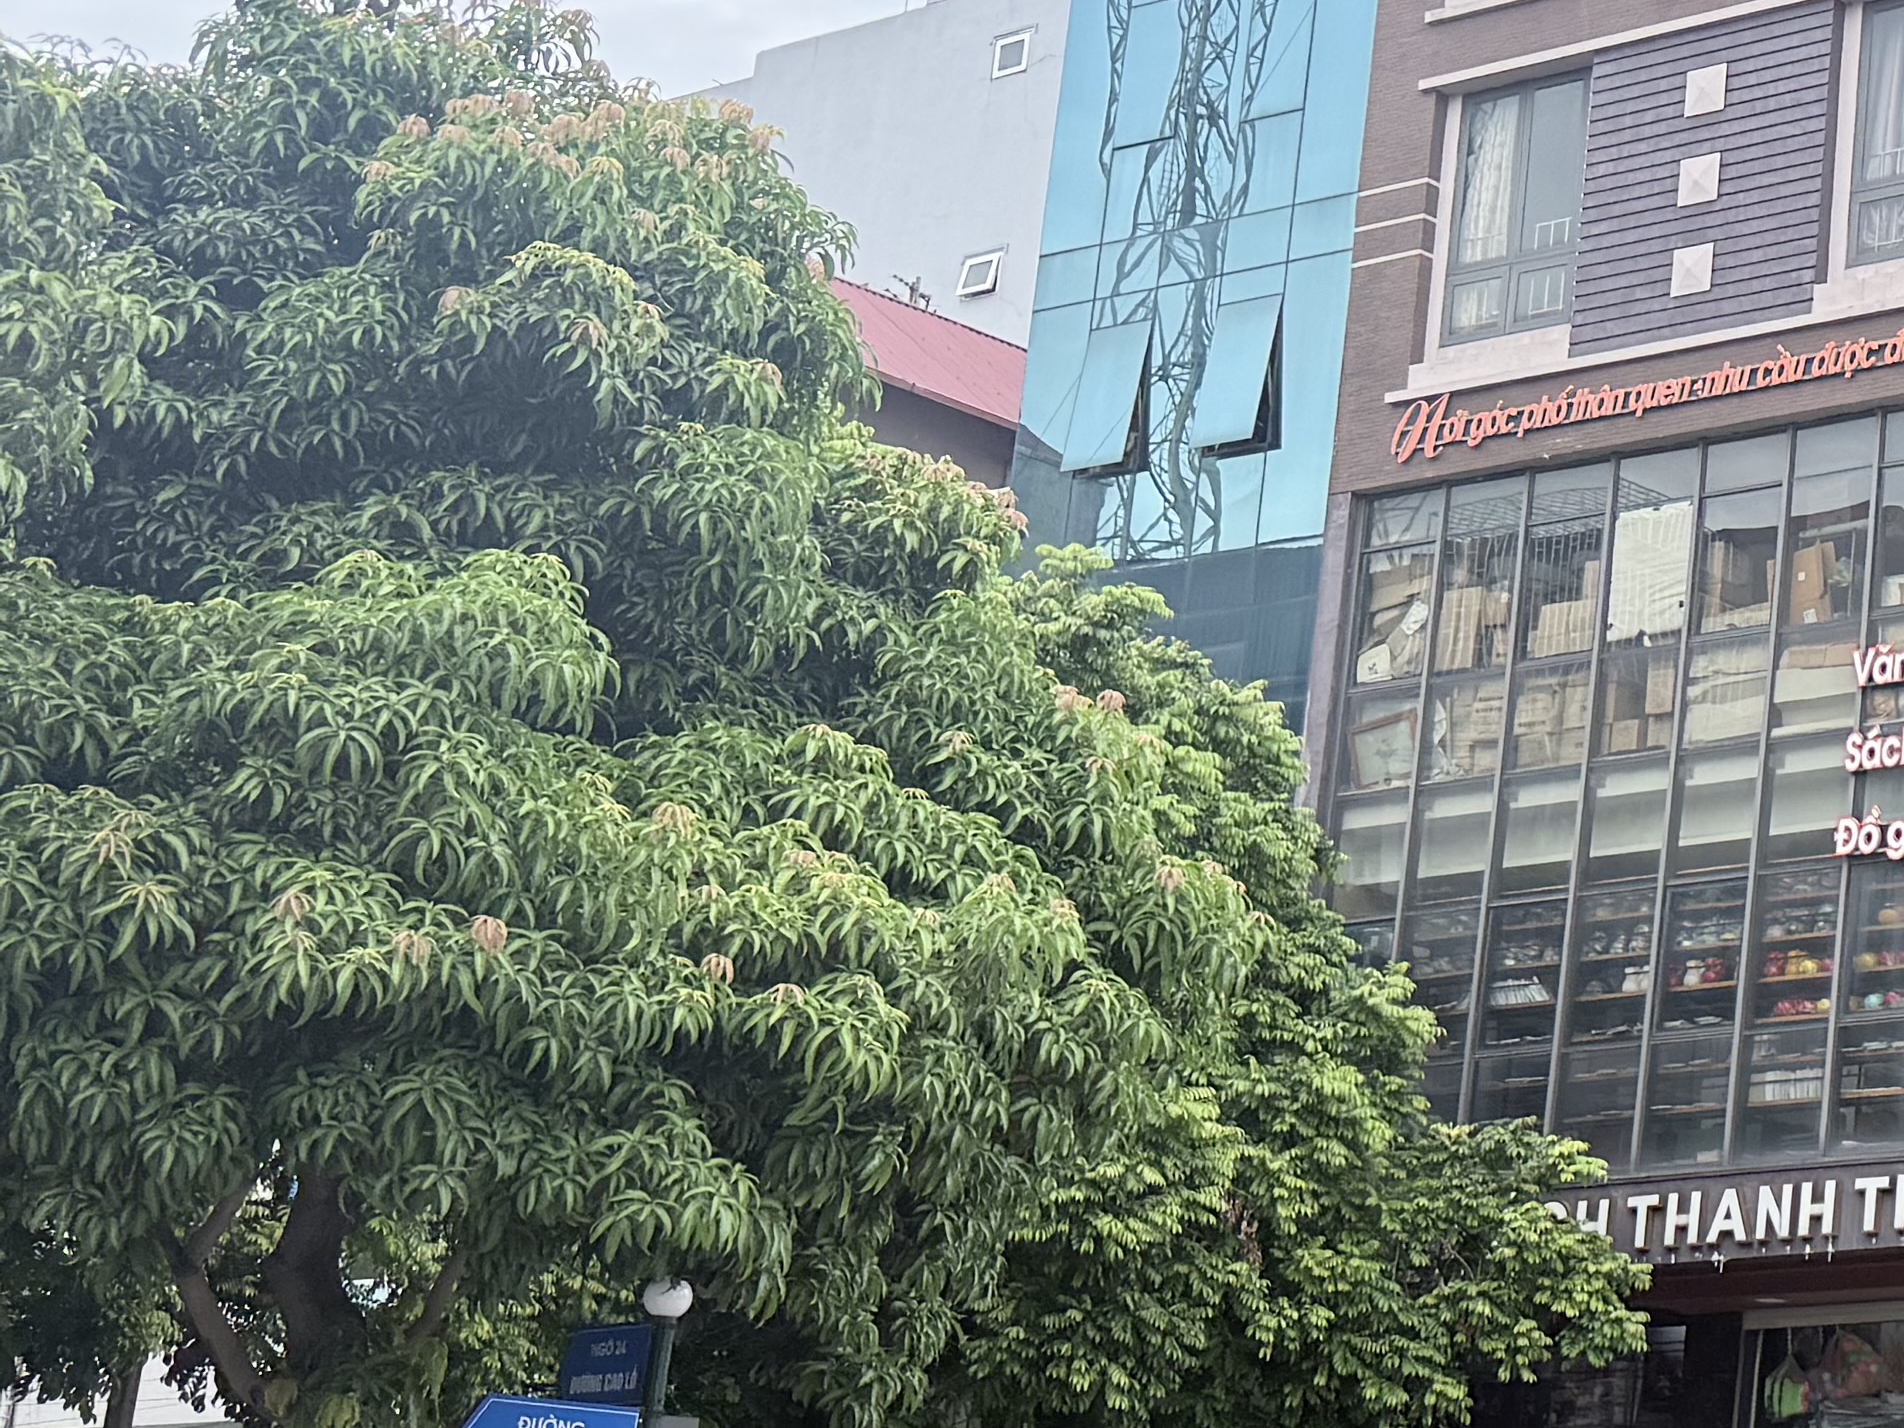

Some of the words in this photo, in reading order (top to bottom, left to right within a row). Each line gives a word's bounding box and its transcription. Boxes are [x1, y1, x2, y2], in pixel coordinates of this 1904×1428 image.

[1469, 399, 1518, 447] góc
[1516, 385, 1574, 438] phố
[1570, 384, 1624, 421] thân
[1628, 376, 1692, 418] quen
[1701, 361, 1750, 396] nhu
[1812, 337, 1879, 379] được
[1834, 804, 1882, 856] Đồ
[1627, 1180, 1837, 1250] THANH
